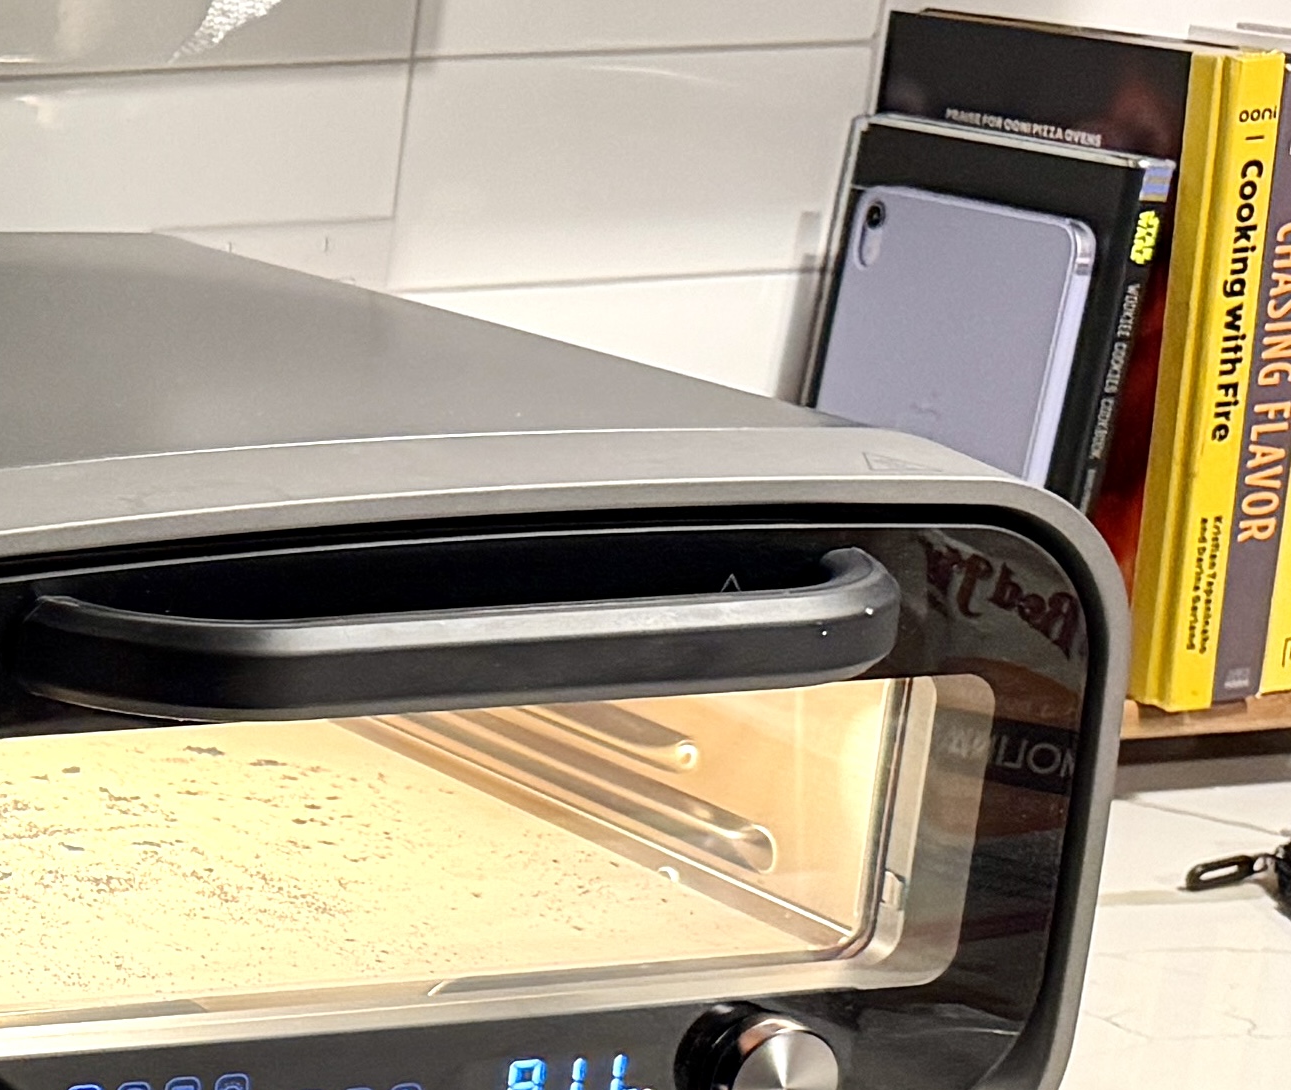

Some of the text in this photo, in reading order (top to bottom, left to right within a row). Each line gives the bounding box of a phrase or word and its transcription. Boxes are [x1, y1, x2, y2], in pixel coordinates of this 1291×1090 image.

[981, 113, 1003, 129] FOR
[1032, 122, 1064, 141] PIZZA
[1064, 128, 1103, 148] OVENS
[1238, 105, 1277, 123] ooni
[1211, 159, 1264, 442] Cooking with Fire
[1237, 401, 1291, 543] FLAVOR
